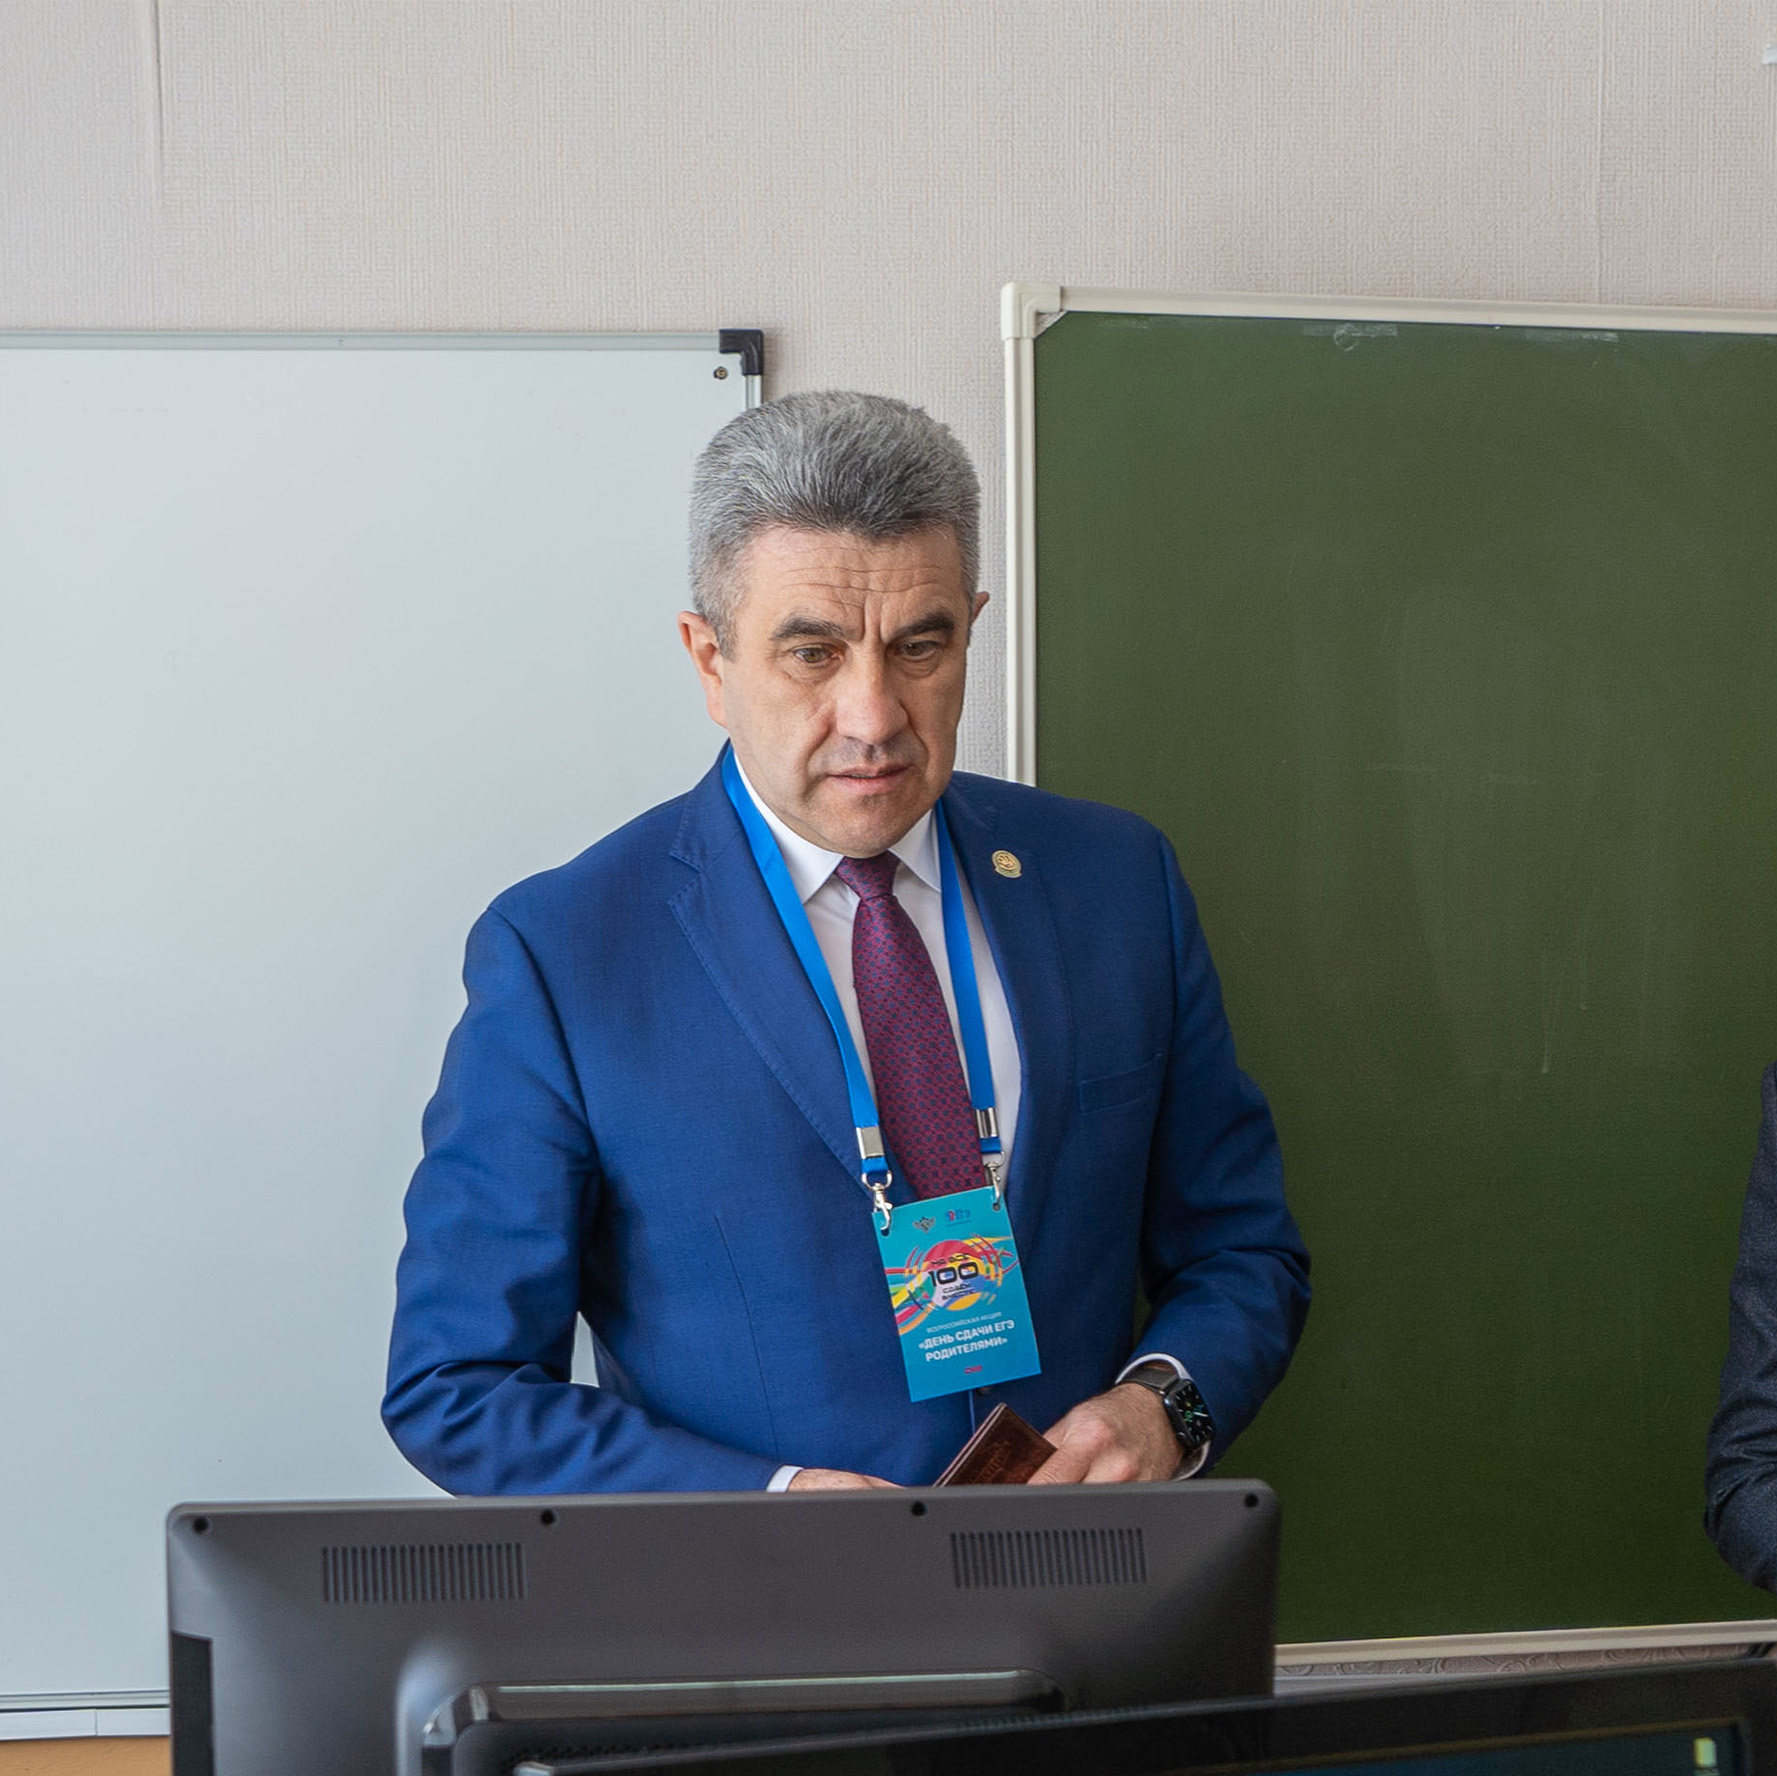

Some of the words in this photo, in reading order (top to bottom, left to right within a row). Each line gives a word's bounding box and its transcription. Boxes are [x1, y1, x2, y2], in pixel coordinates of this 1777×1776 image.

[928, 1262, 978, 1287] 100
[918, 1332, 954, 1350] «ДЕНЬ
[956, 1324, 993, 1342] СДАЧИ
[995, 1320, 1015, 1333] ЕГЭ
[925, 1336, 1007, 1362] РОДИТЕЛЯМИ»
